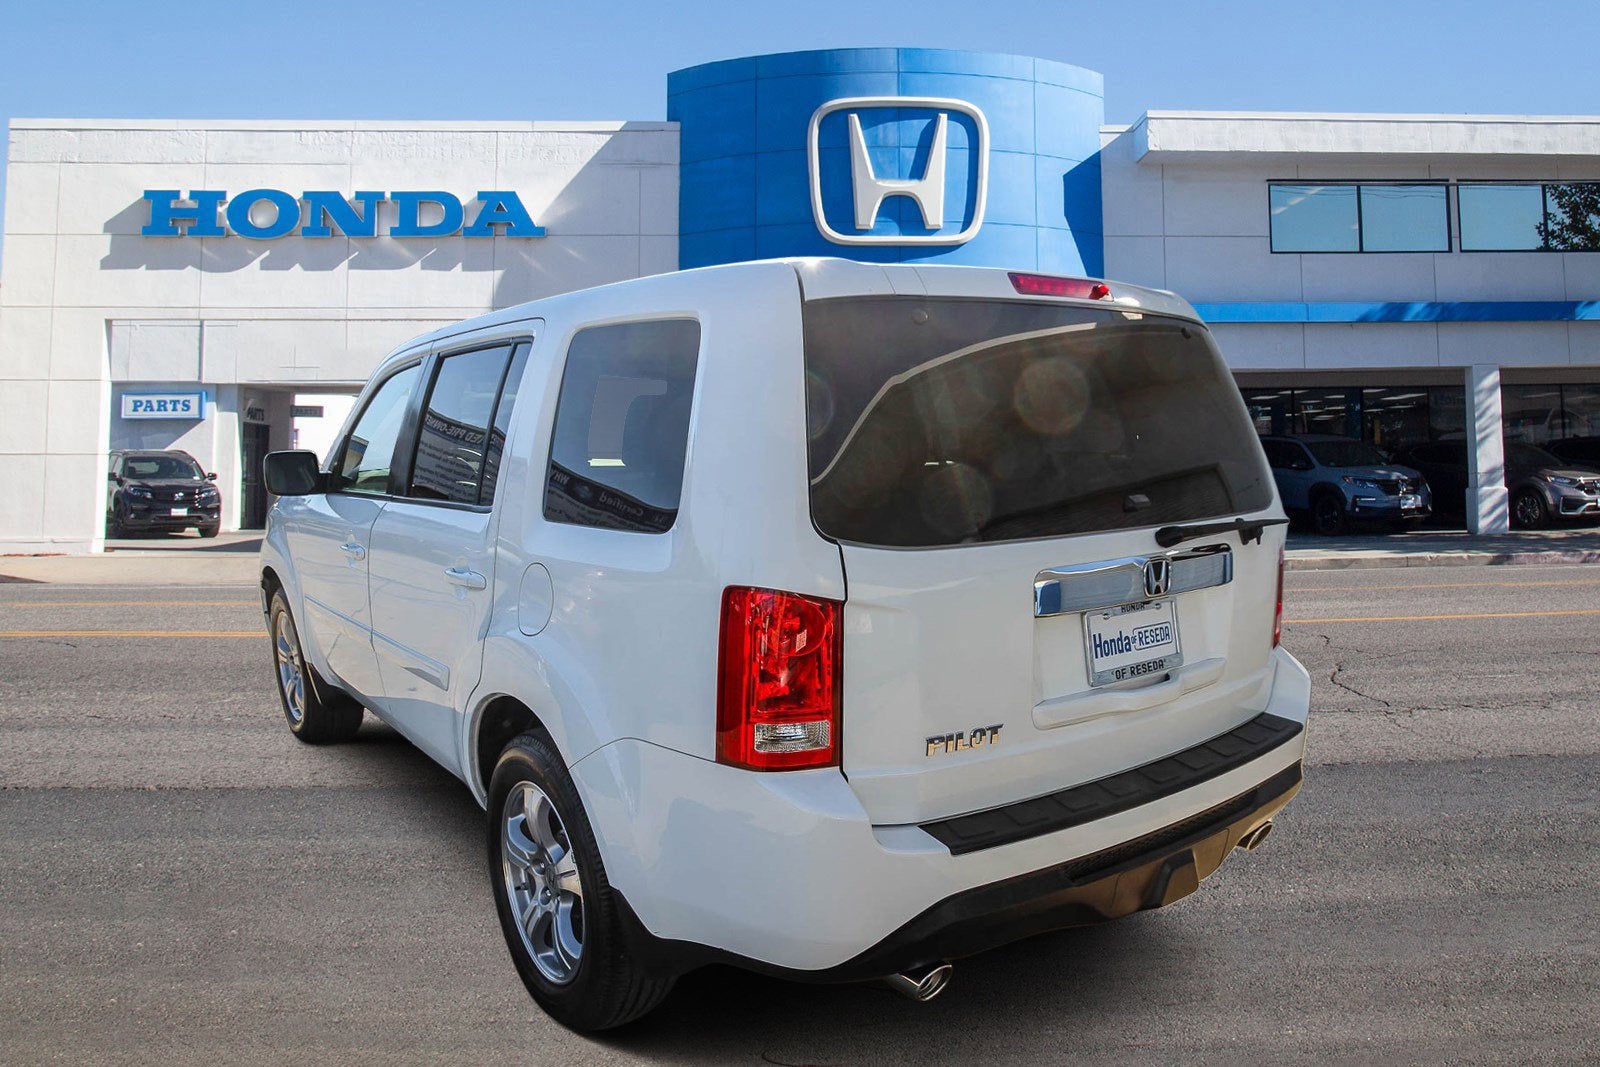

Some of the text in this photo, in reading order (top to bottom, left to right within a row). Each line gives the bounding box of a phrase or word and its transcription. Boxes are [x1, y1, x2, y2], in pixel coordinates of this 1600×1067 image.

[142, 189, 547, 239] HONDA
[132, 399, 192, 412] PARTS
[1093, 630, 1132, 659] Honda
[1138, 627, 1170, 645] RESEDA
[1115, 659, 1165, 680] OF RESEDA
[926, 723, 1004, 757] PILOT
